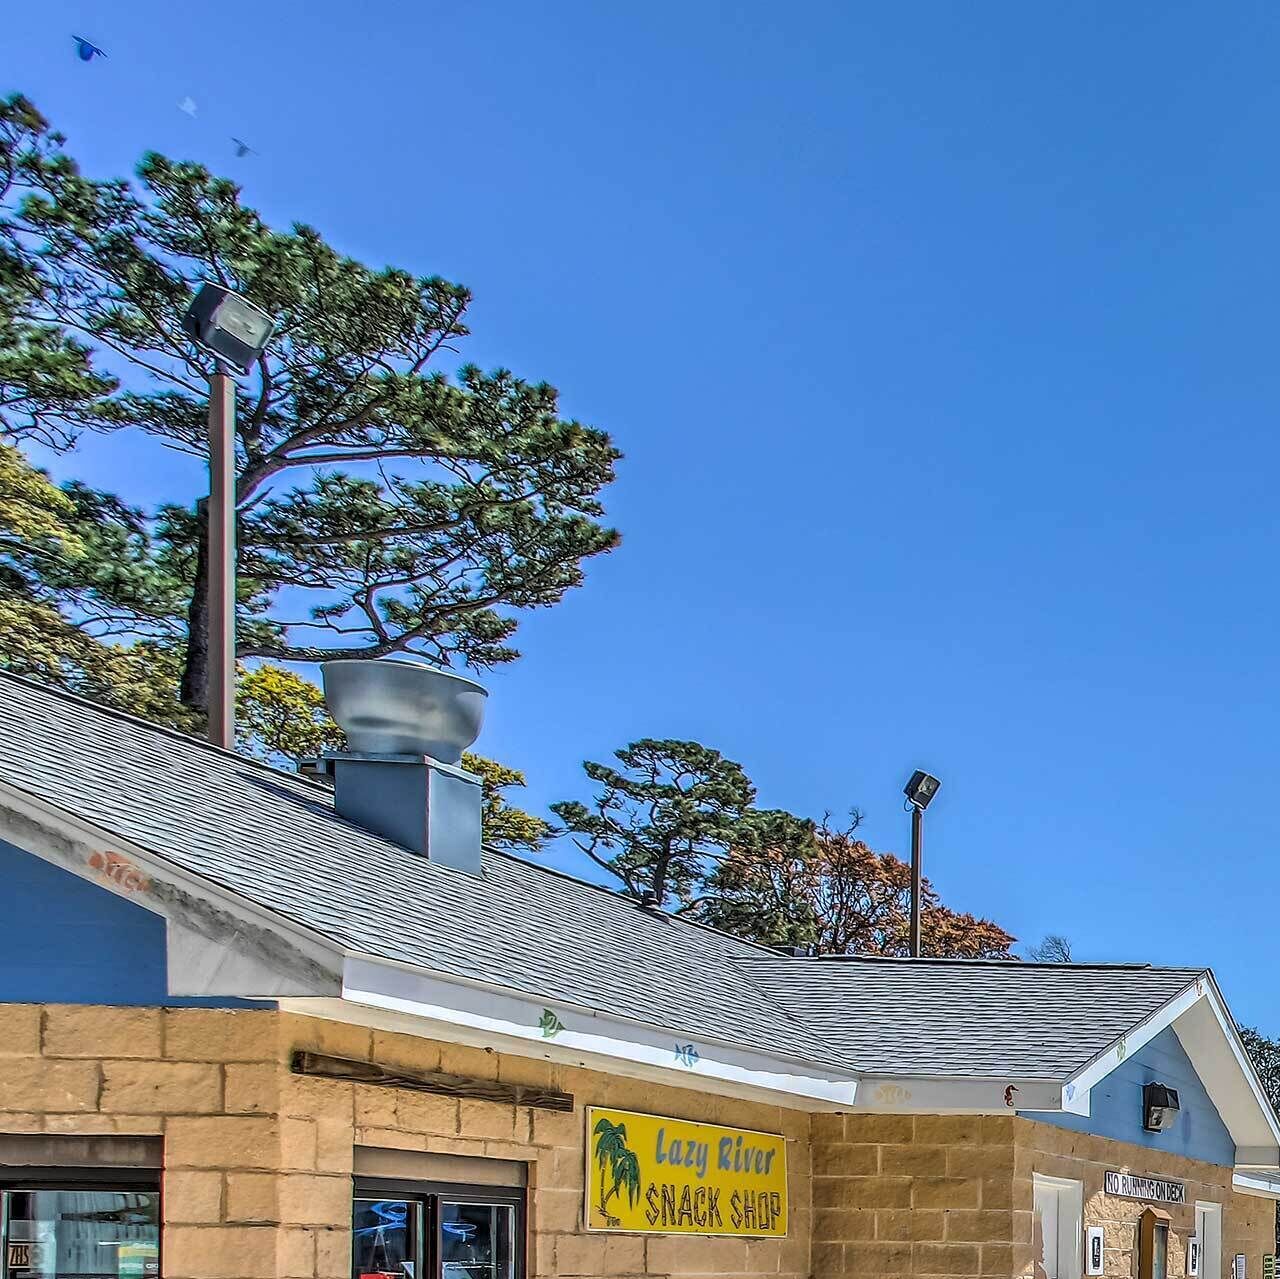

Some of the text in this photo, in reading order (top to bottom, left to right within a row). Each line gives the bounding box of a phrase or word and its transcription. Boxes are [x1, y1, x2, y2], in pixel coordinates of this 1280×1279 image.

[656, 1128, 776, 1179] Lazy River
[645, 1182, 781, 1231] SNACK SHOP
[1107, 1173, 1184, 1202] NO RUNNING ON DECK
